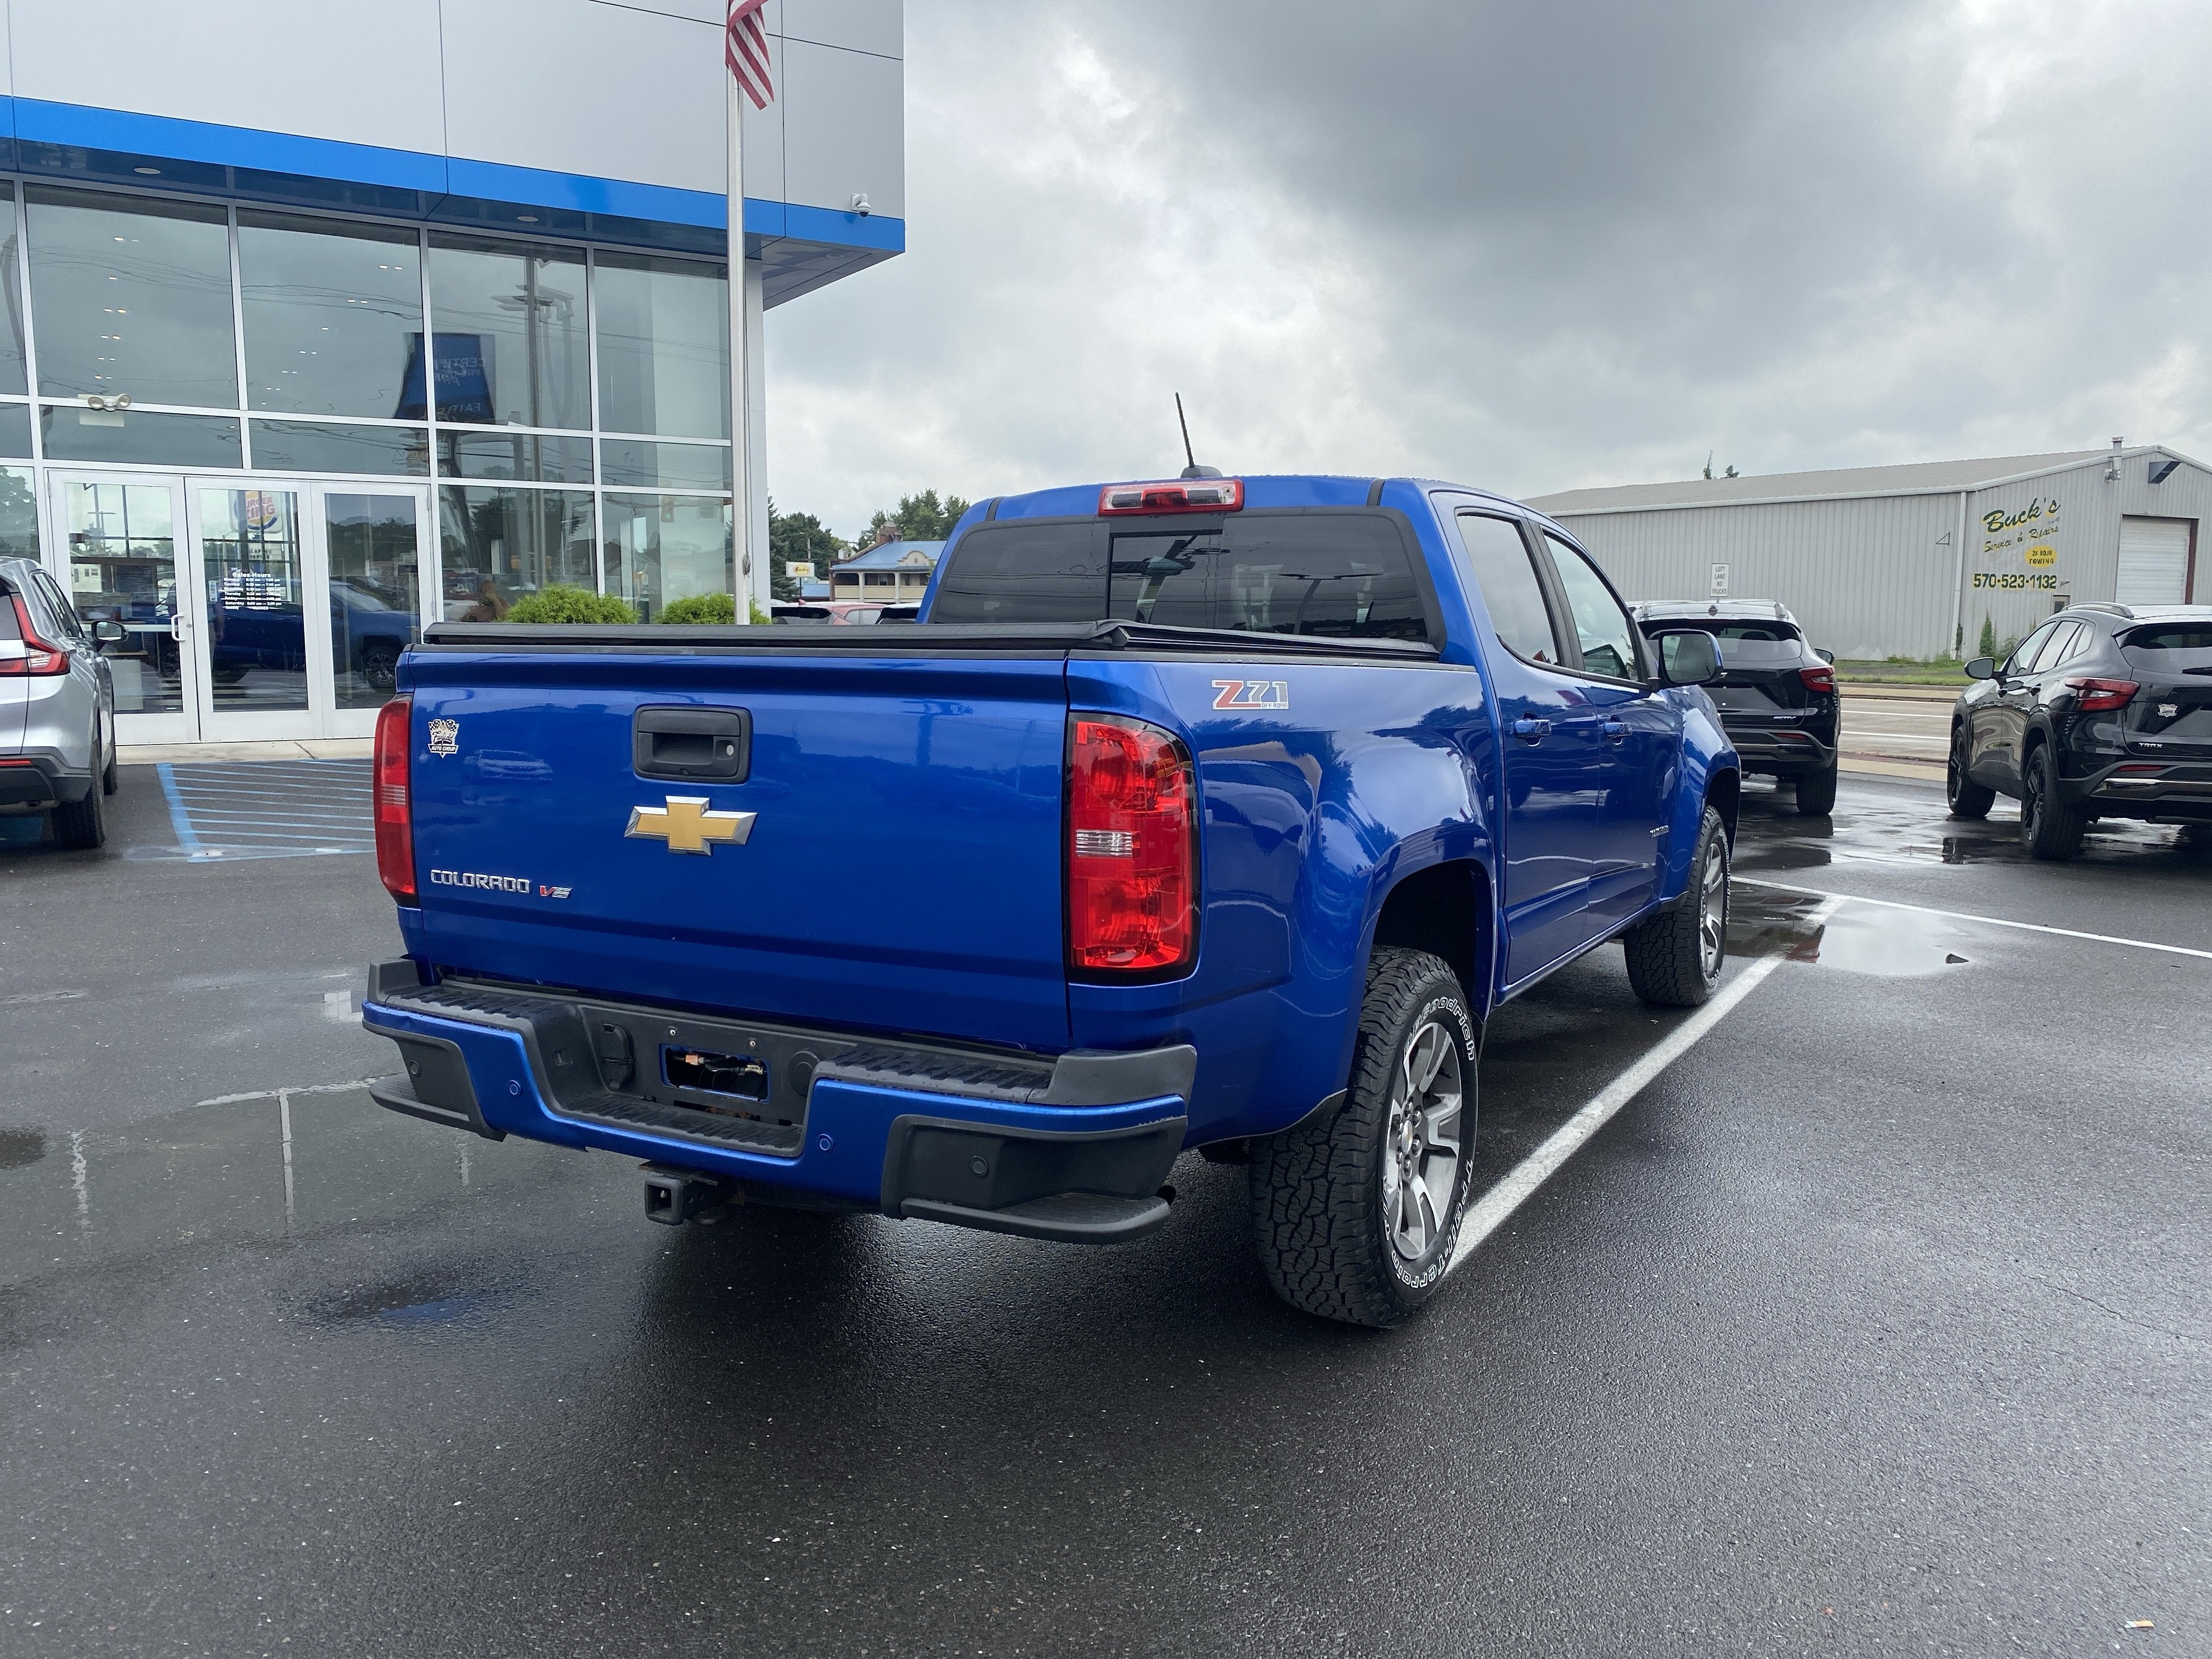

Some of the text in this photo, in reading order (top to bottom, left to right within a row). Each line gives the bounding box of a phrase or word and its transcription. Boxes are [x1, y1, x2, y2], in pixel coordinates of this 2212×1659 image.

[1983, 497, 2061, 533] Buck's
[1984, 539, 2012, 553] Service
[2029, 526, 2059, 540] Repairs
[1973, 573, 2057, 589] 570-523-1132
[1211, 680, 1288, 709] Z71
[430, 869, 572, 899] COLORADO V6
